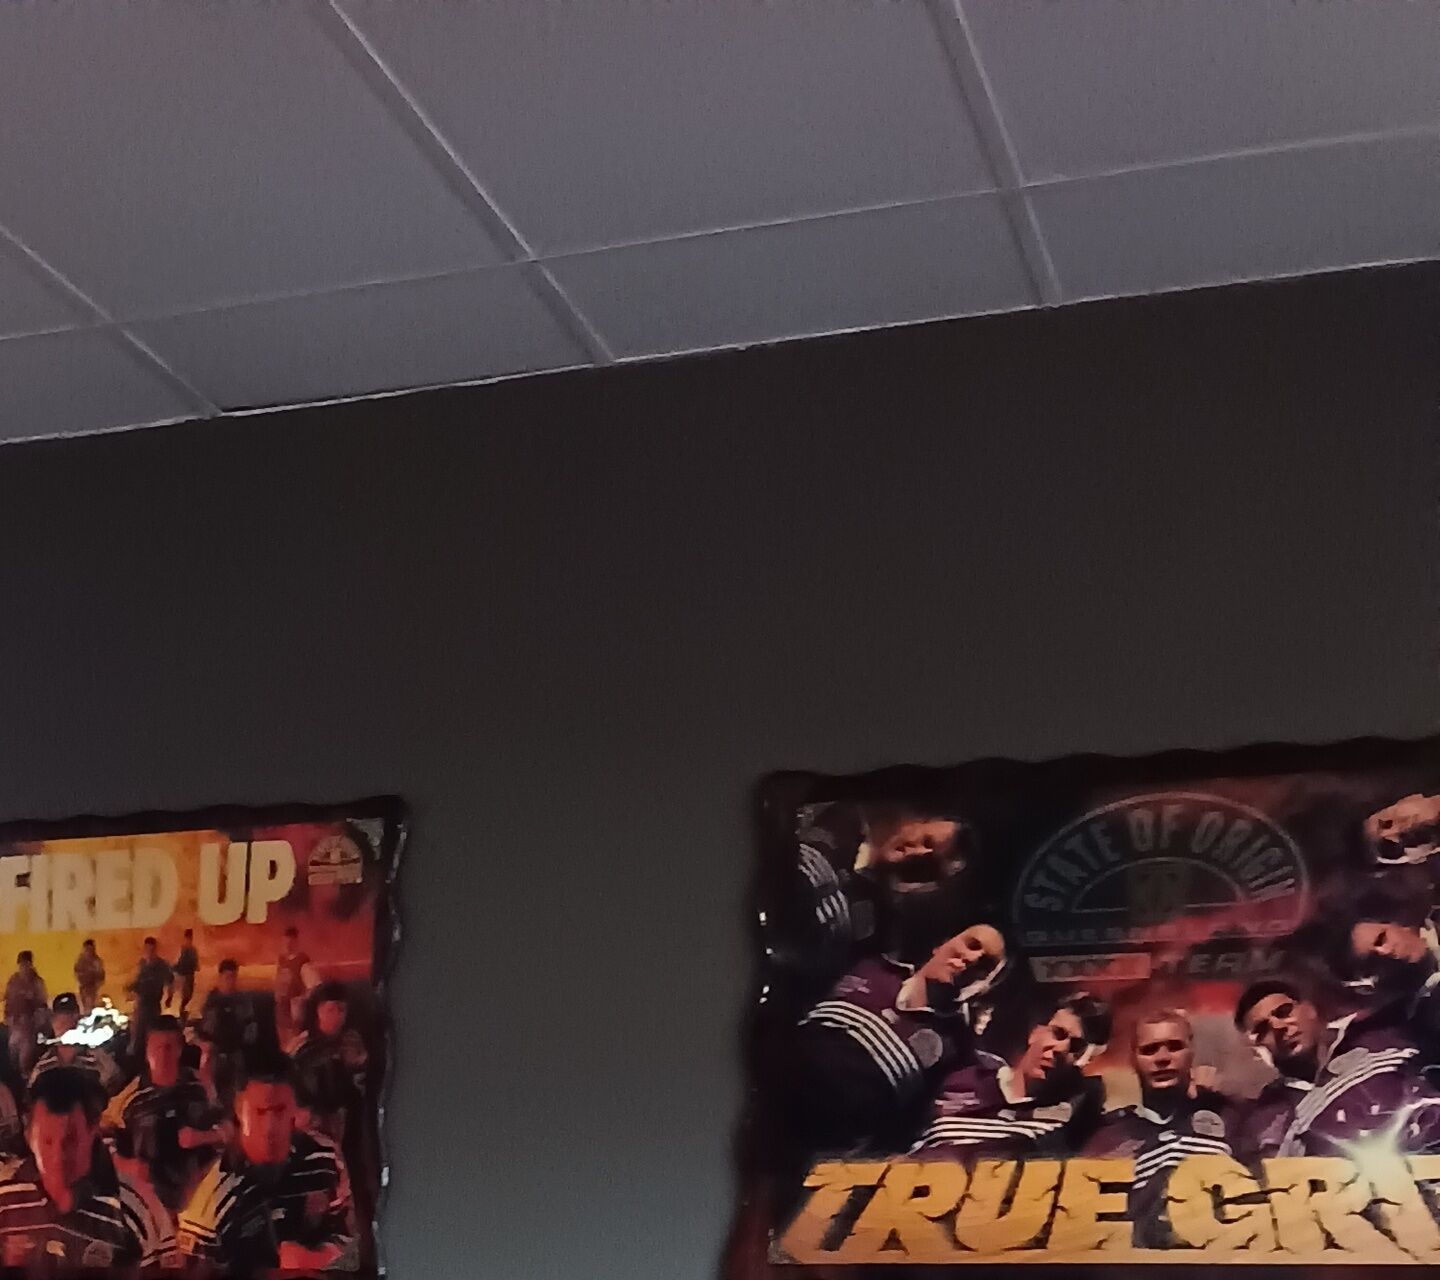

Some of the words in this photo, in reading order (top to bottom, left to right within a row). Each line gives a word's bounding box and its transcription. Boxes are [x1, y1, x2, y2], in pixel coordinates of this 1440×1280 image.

[197, 839, 296, 926] UP
[1023, 822, 1122, 912] STATE
[1126, 804, 1185, 852] OF
[1190, 811, 1297, 903] ORIGIN
[780, 1156, 1134, 1251] TRUE
